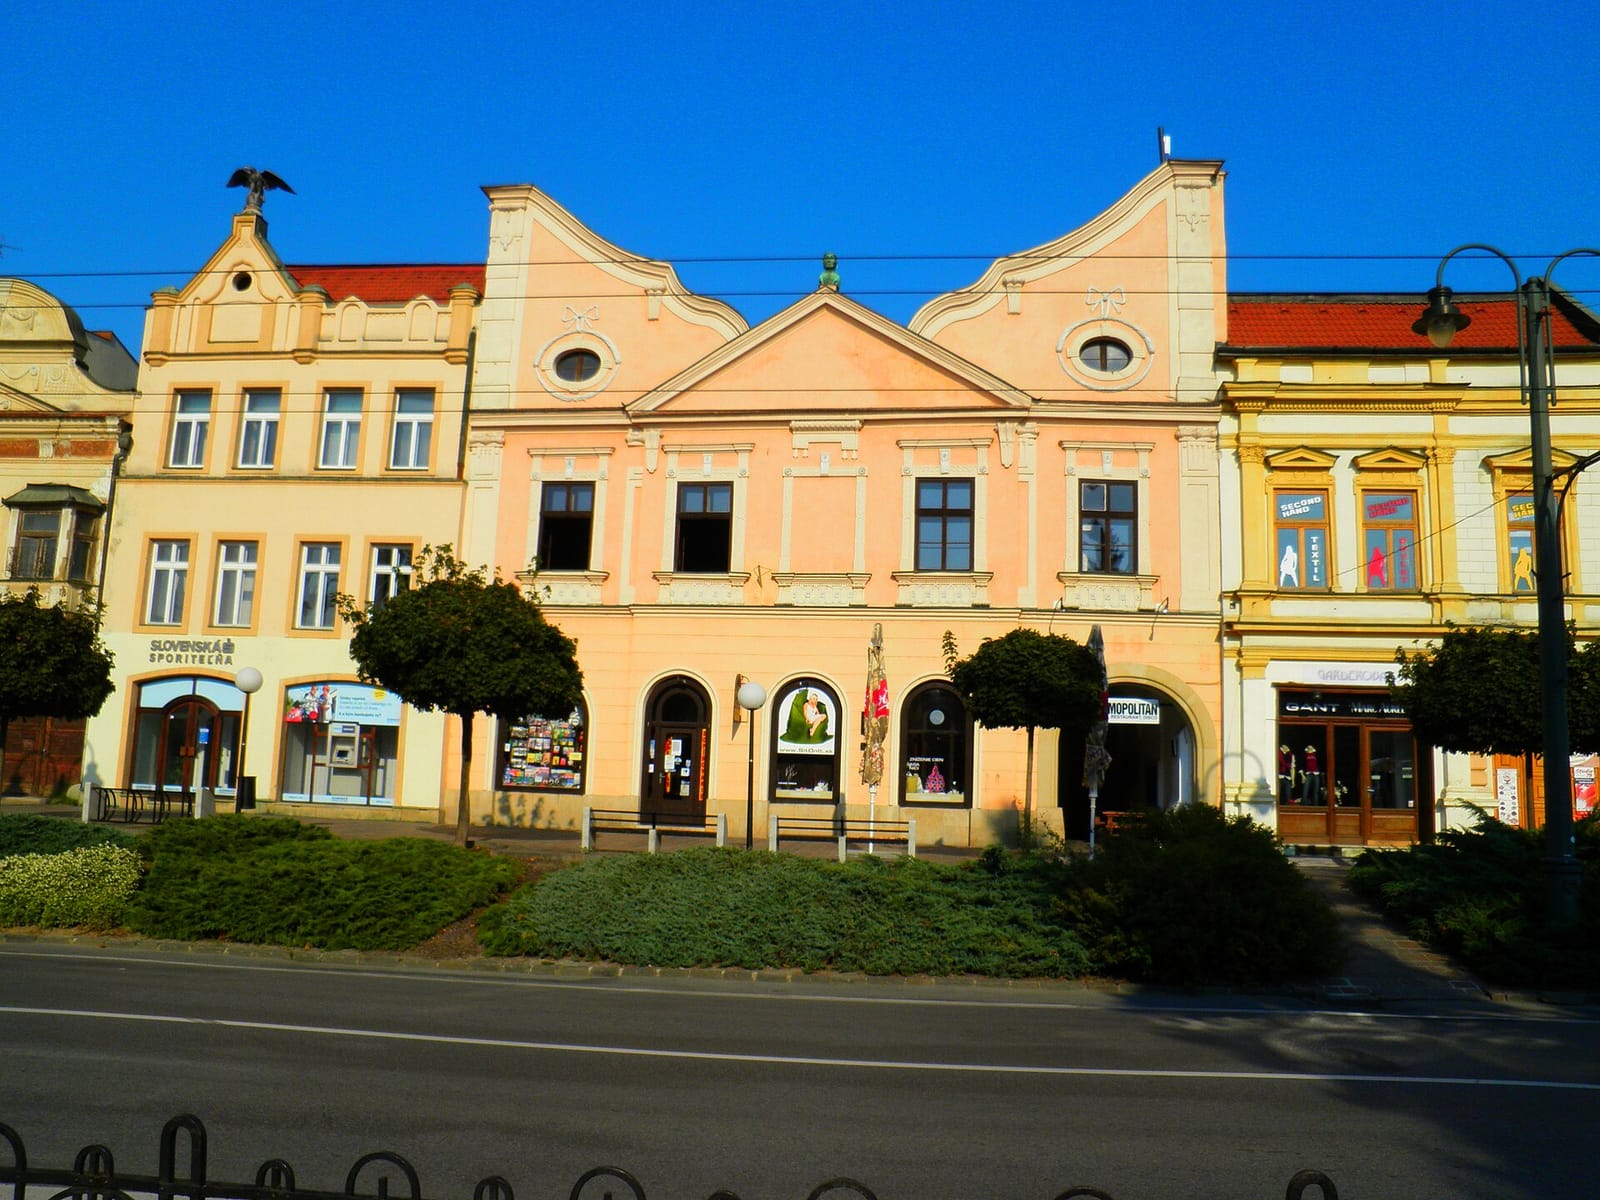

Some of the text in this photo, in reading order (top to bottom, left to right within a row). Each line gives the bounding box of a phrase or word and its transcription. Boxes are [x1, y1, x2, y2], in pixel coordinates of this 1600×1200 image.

[1280, 497, 1321, 511] SECOND
[1367, 497, 1409, 512] SECOND
[1511, 502, 1534, 512] SEC
[1282, 506, 1310, 518] HAND
[1513, 510, 1534, 518] HAN
[1311, 536, 1320, 581] TEXTIL
[150, 639, 222, 653] SLOVENSKÁ
[1108, 702, 1158, 715] MOPOLITAN
[1285, 702, 1340, 712] GANT
